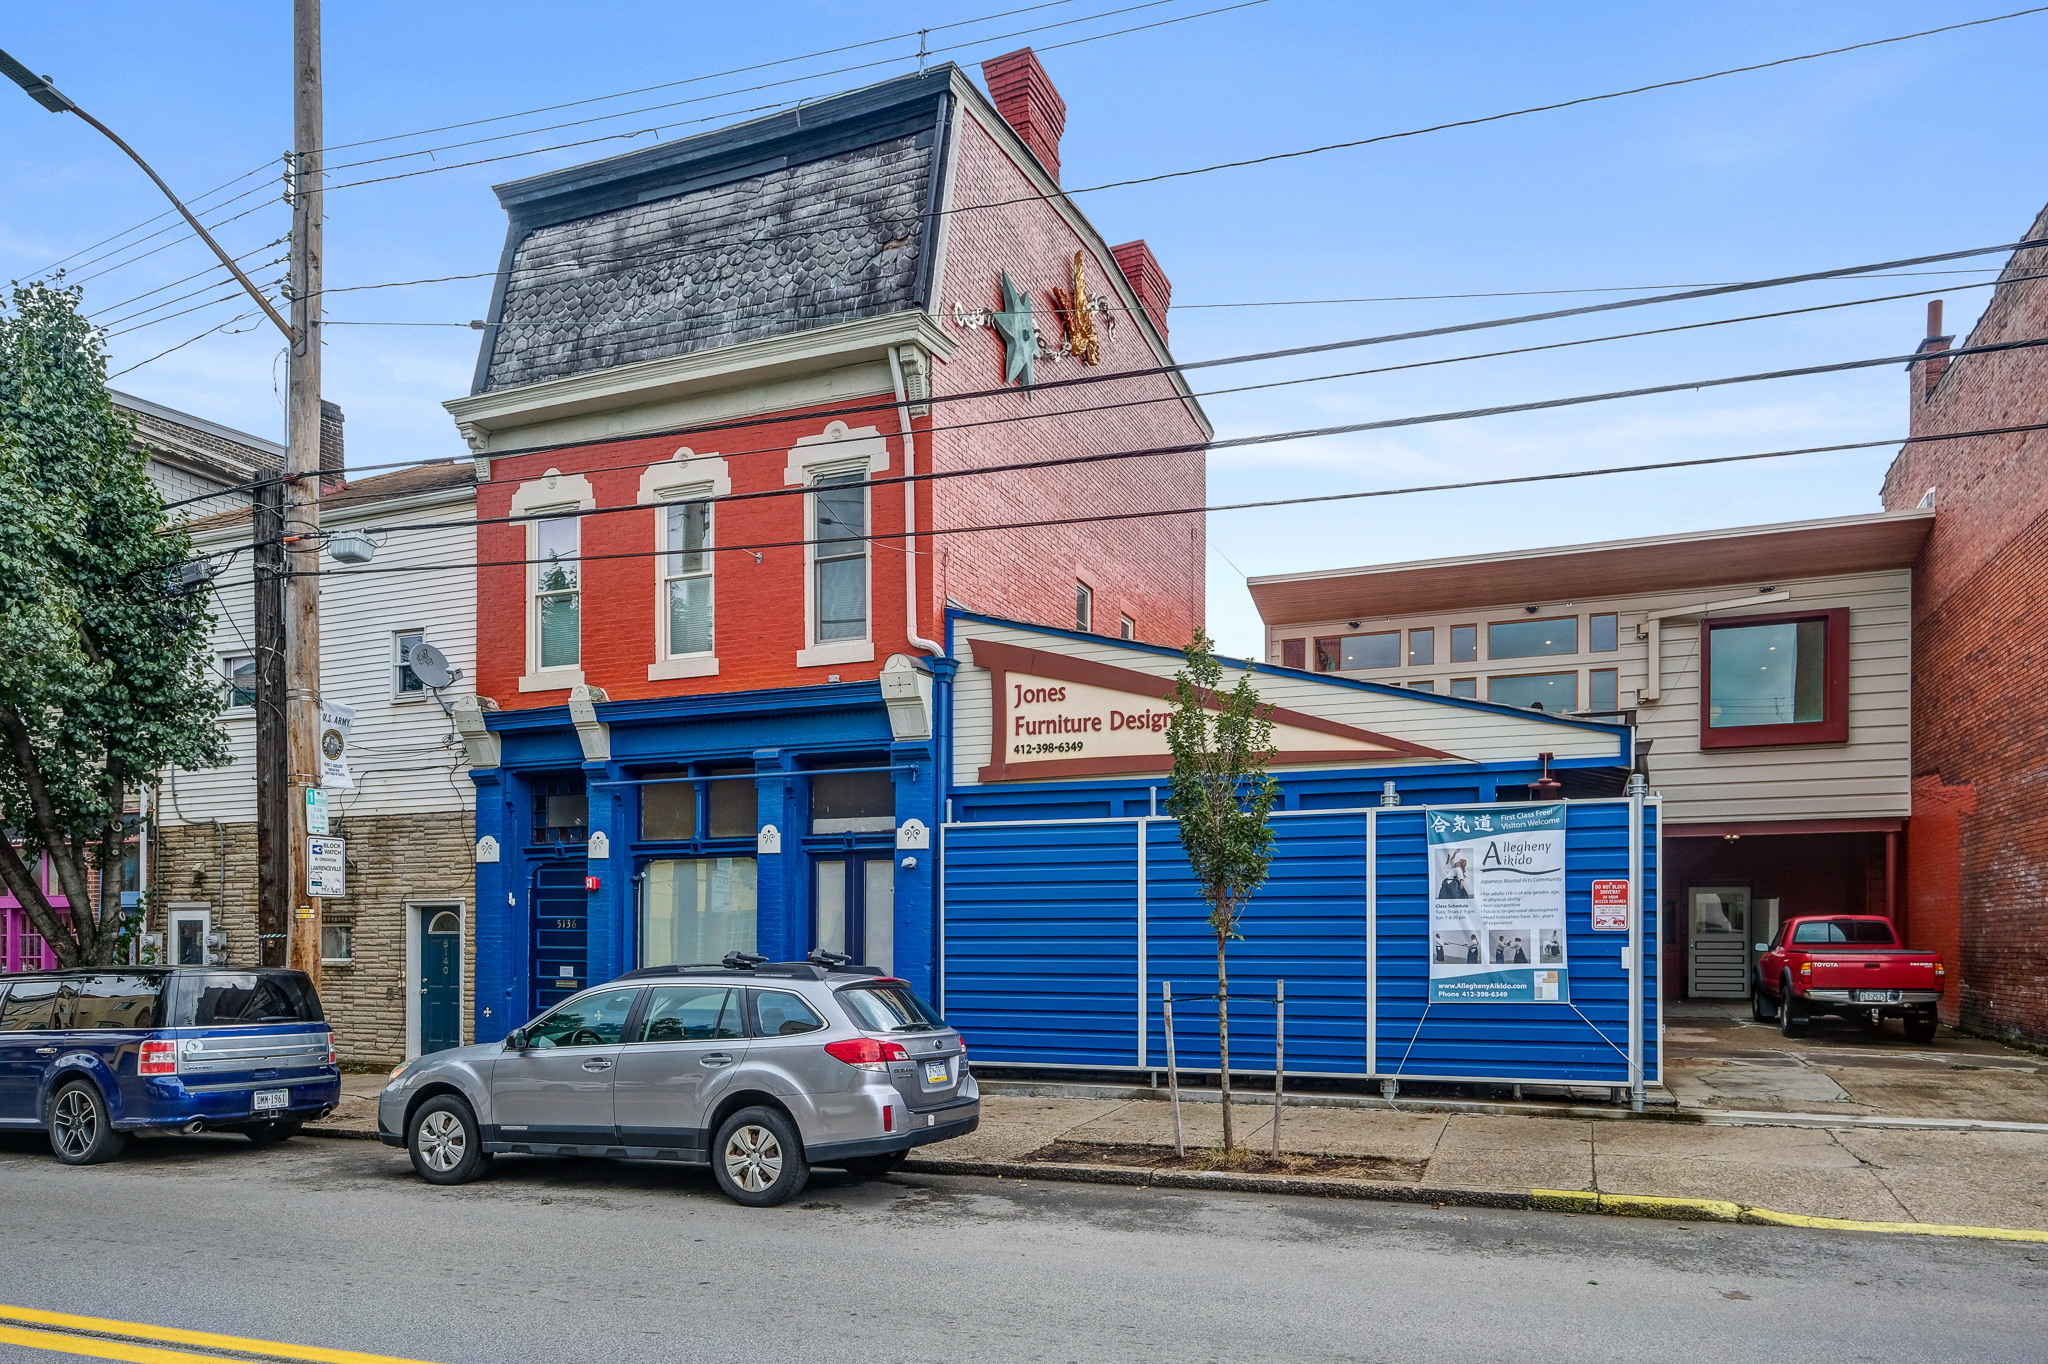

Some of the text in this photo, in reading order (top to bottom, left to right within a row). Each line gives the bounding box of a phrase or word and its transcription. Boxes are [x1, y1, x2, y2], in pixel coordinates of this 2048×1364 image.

[1014, 684, 1066, 708] Jones
[322, 713, 351, 727] U.S. ARMY
[1014, 714, 1102, 736] Furniture
[1014, 741, 1083, 754] 412-398-6349
[309, 791, 314, 802] 1
[1536, 808, 1553, 816] Free!
[1430, 814, 1494, 834] 合気道
[1501, 817, 1560, 829] Visitors Welcome
[557, 919, 577, 929] 5136
